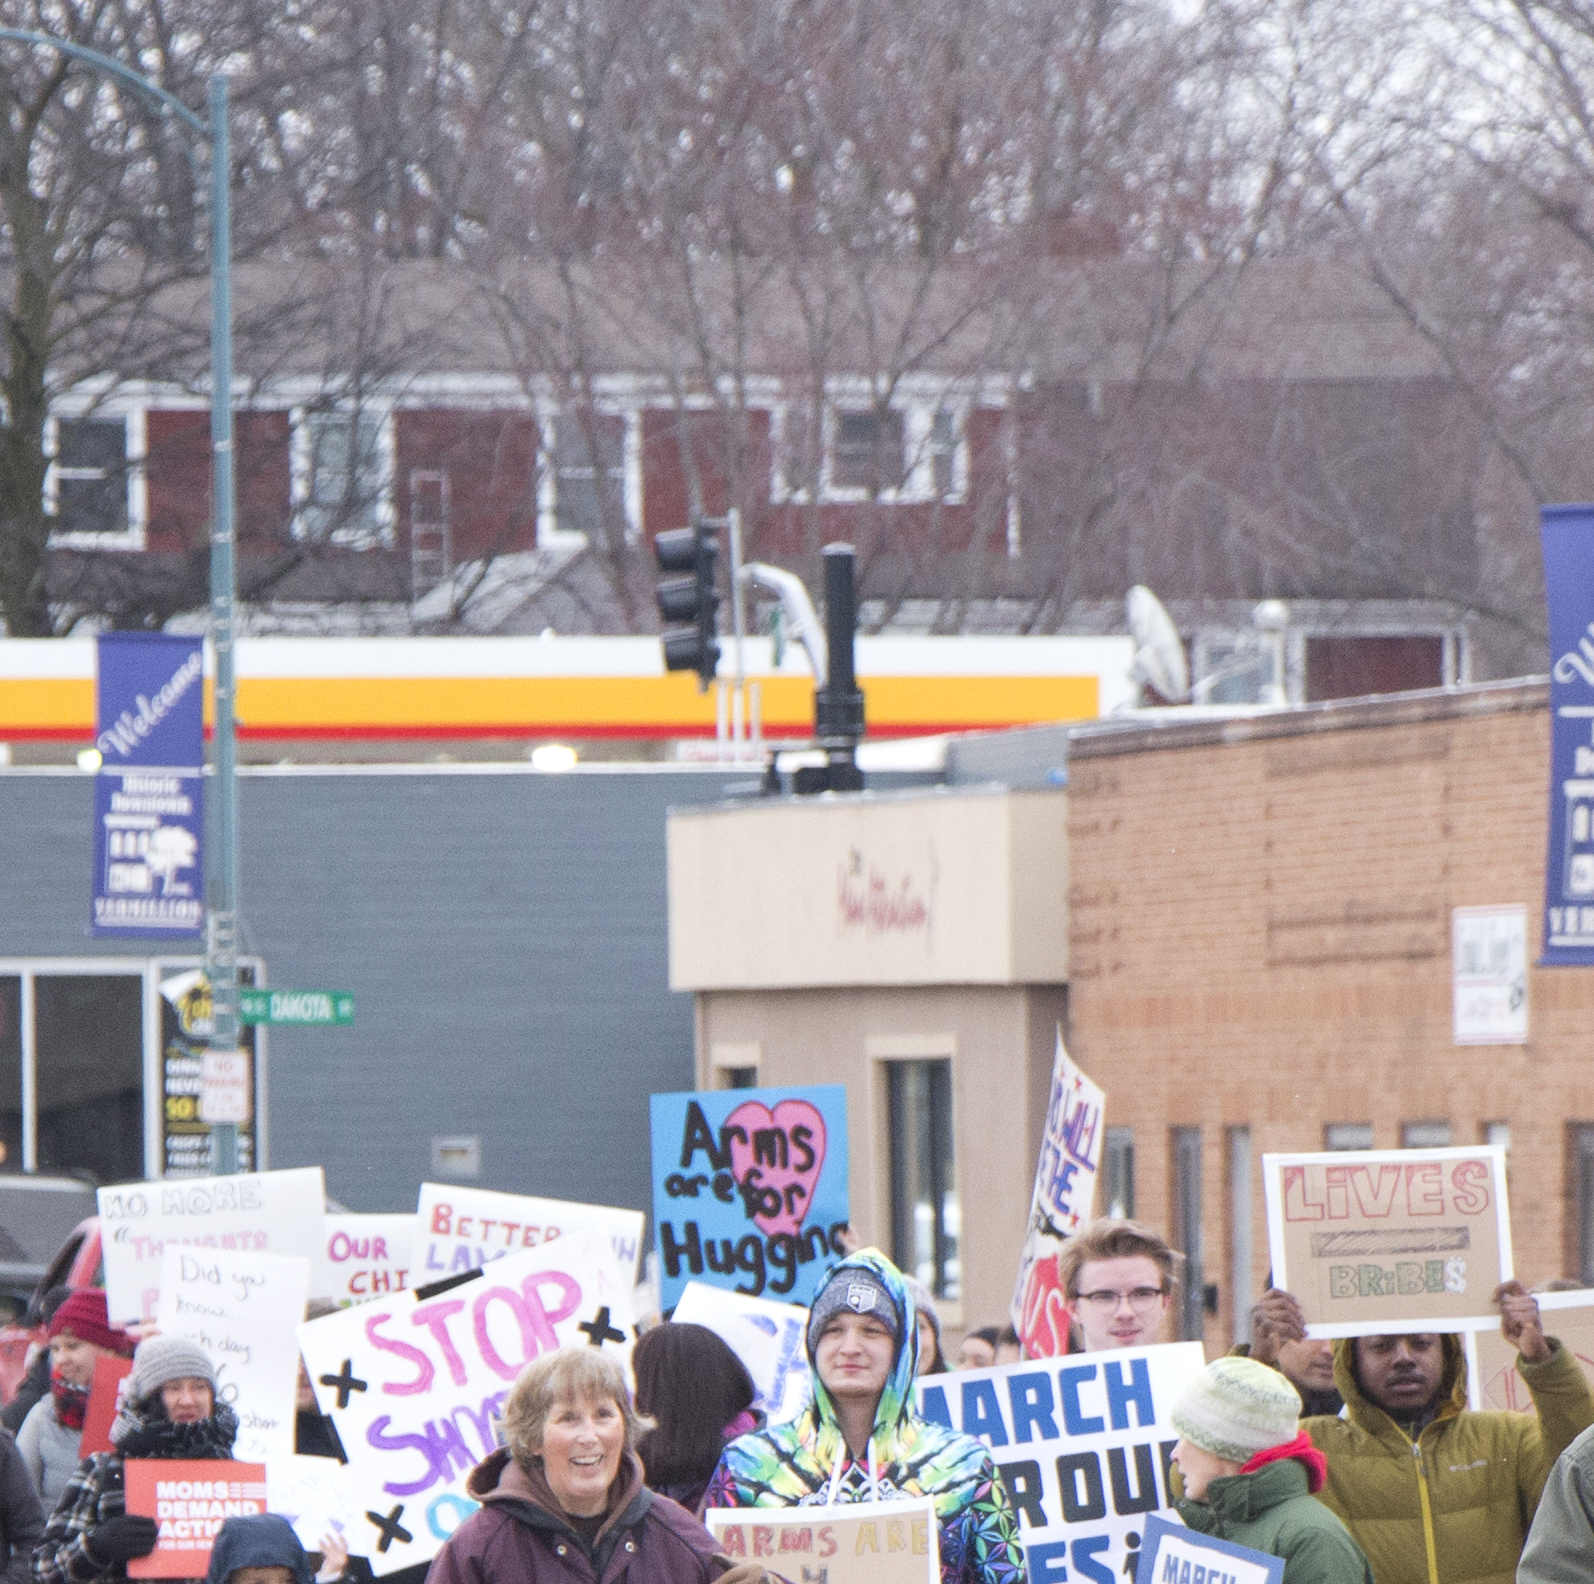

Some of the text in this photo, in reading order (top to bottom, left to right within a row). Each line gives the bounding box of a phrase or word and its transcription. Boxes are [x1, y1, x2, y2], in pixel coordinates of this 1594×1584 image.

[97, 652, 201, 756] Welcome
[95, 898, 202, 919] VERMILLION
[270, 993, 333, 1020] DAKOTA
[680, 1100, 815, 1173] Arms
[105, 1179, 263, 1219] NO MORE
[665, 1167, 806, 1219] are for
[431, 1202, 562, 1248] BETTER
[327, 1231, 389, 1263] OUR
[180, 1254, 265, 1302] Did you
[348, 1270, 409, 1296] CHI
[365, 1270, 582, 1396] STOP
[157, 1481, 229, 1499] MOMS
[1056, 1438, 1180, 1524] OU
[157, 1501, 259, 1518] DEMAND
[723, 1520, 928, 1557] ARMS ARE
